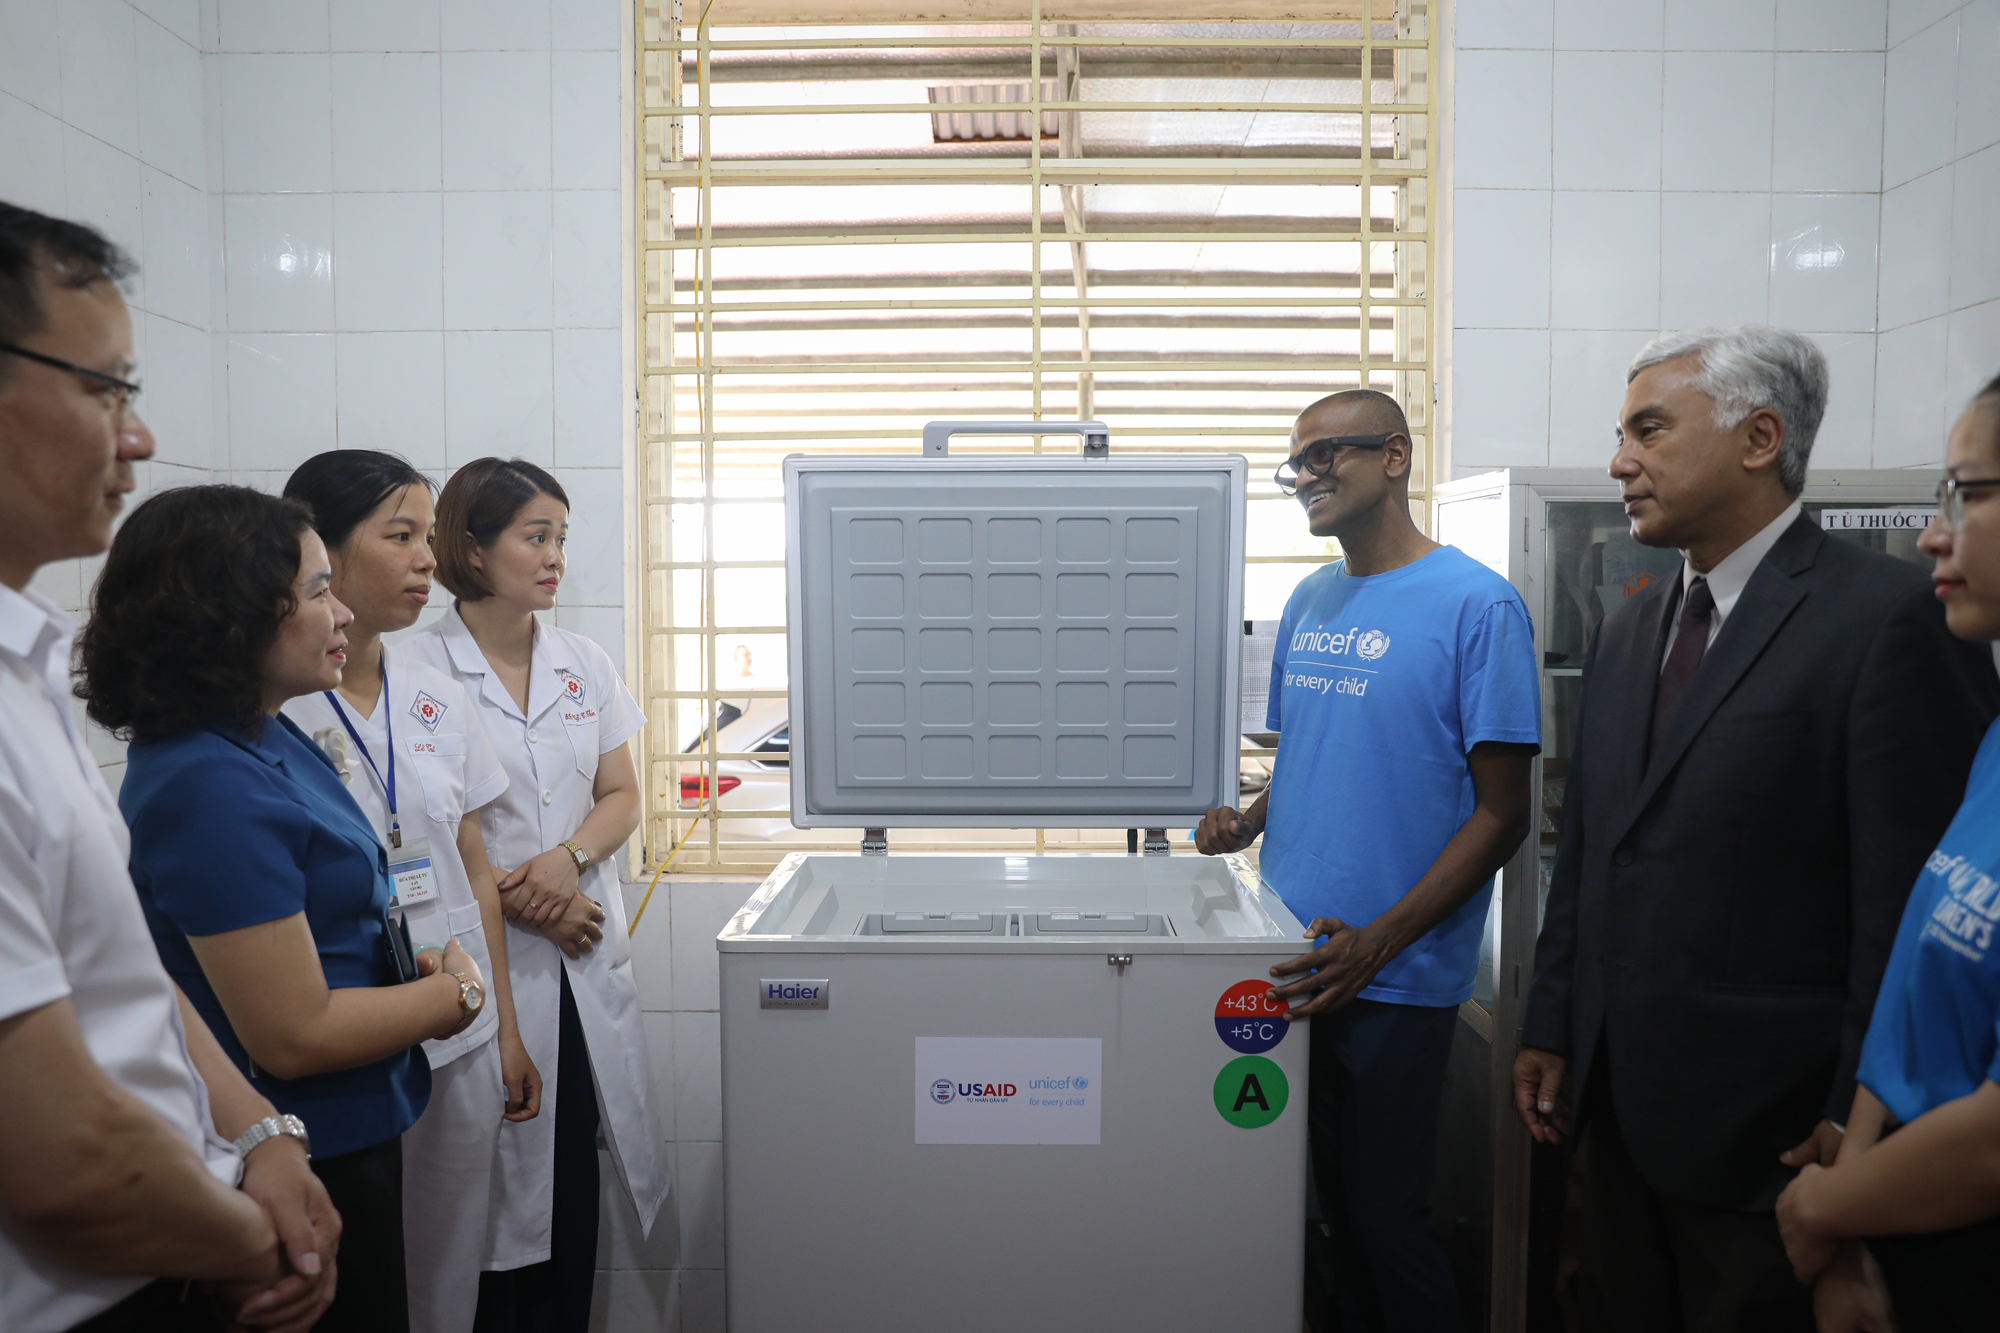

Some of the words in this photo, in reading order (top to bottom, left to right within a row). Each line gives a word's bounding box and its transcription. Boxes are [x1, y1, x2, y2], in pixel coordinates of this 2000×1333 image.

[1857, 511, 1917, 528] THUỐC
[1292, 624, 1359, 655] unicef
[1285, 669, 1295, 687] for
[1295, 673, 1334, 695] every
[1336, 675, 1369, 697] child
[769, 983, 819, 999] Haier
[1224, 993, 1278, 1012] +43°C
[1231, 1021, 1274, 1041] +5°C
[958, 1083, 1017, 1097] USAID
[1029, 1076, 1071, 1090] unicef
[1232, 1073, 1270, 1112] A
[1029, 1097, 1040, 1106] for
[1042, 1099, 1064, 1108] every
[1065, 1098, 1085, 1106] child
